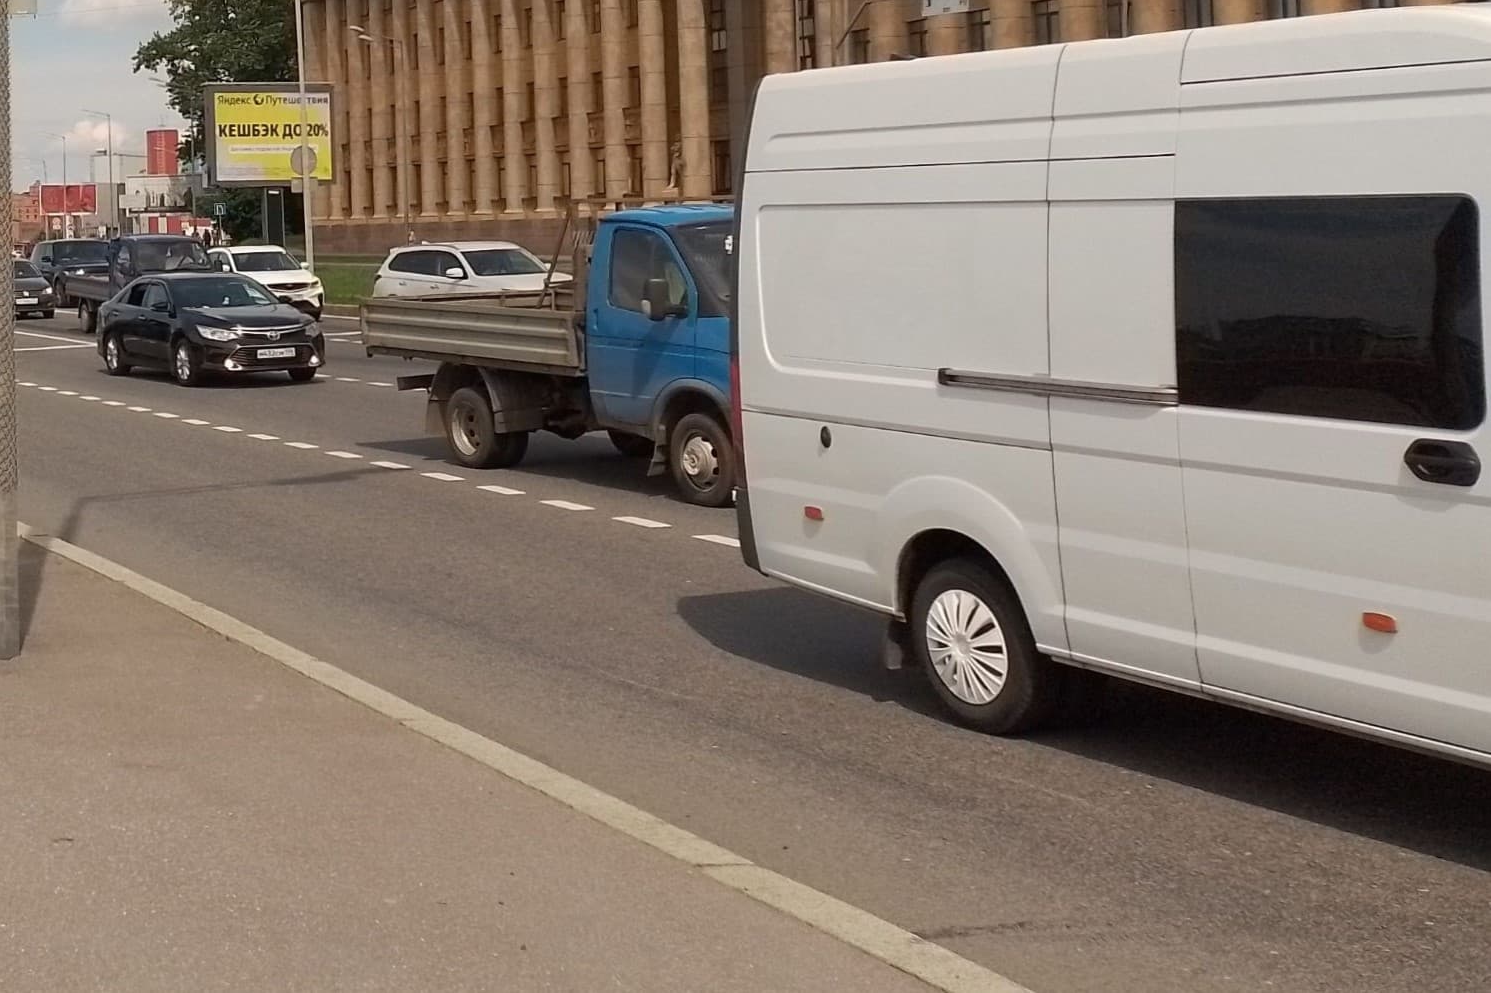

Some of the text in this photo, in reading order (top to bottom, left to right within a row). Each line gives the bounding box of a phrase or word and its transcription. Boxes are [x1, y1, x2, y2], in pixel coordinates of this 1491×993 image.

[217, 95, 329, 107] Яндекс Путешетвия
[218, 123, 329, 140] КЕШБЭК ДО 20%
